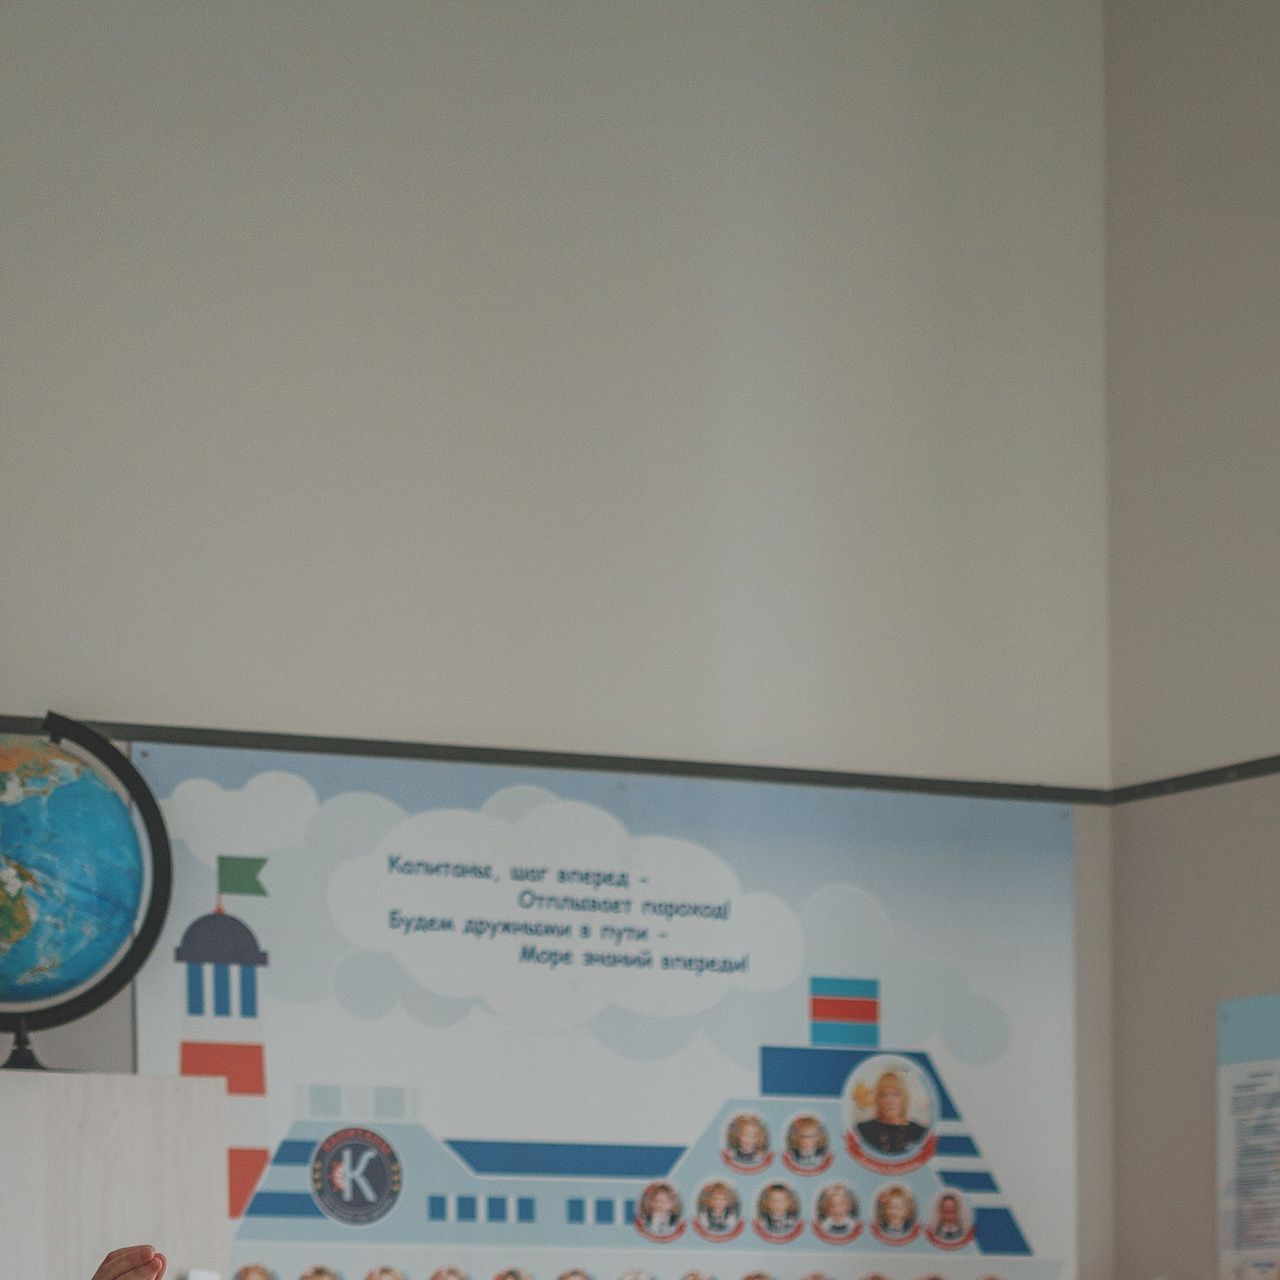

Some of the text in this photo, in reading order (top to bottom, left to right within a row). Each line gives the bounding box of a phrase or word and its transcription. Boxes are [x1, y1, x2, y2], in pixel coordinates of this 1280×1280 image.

[387, 855, 500, 882] Капитаны,
[509, 867, 549, 882] шаг
[557, 868, 630, 889] вперед
[518, 889, 731, 921] Отплывает пароход!
[388, 908, 455, 935] Будем
[462, 918, 572, 939] дружными
[580, 924, 591, 939] в
[600, 926, 649, 944] пути
[519, 945, 749, 975] Море знаний впереди!
